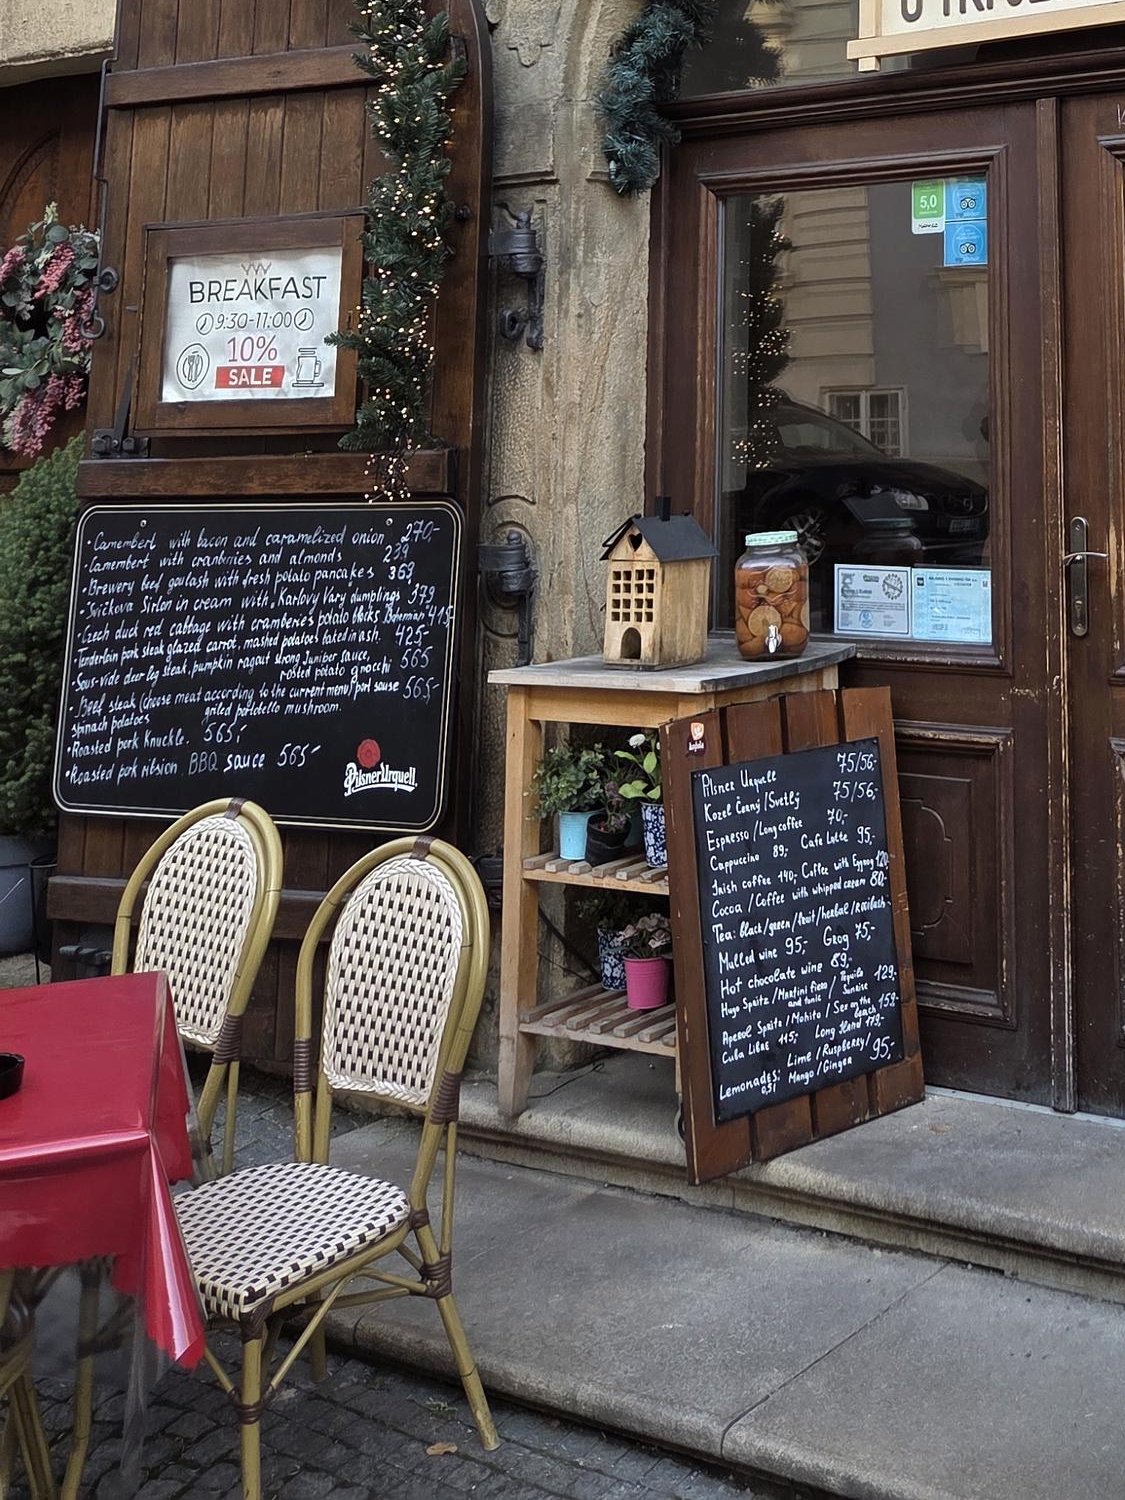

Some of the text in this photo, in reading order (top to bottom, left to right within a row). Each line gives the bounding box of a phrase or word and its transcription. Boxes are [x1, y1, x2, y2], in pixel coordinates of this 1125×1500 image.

[189, 276, 327, 303] BREAKFAST
[226, 335, 278, 362] 10%
[228, 368, 273, 386] SALE
[169, 530, 190, 549] with
[197, 528, 228, 548] bacon
[233, 526, 260, 547] and
[352, 527, 385, 545] onion
[160, 551, 184, 568] with
[259, 547, 282, 565] and
[290, 547, 342, 565] almonds
[214, 569, 239, 589] with
[194, 596, 232, 611] cream
[217, 613, 244, 633] with
[188, 751, 218, 776] BBQ
